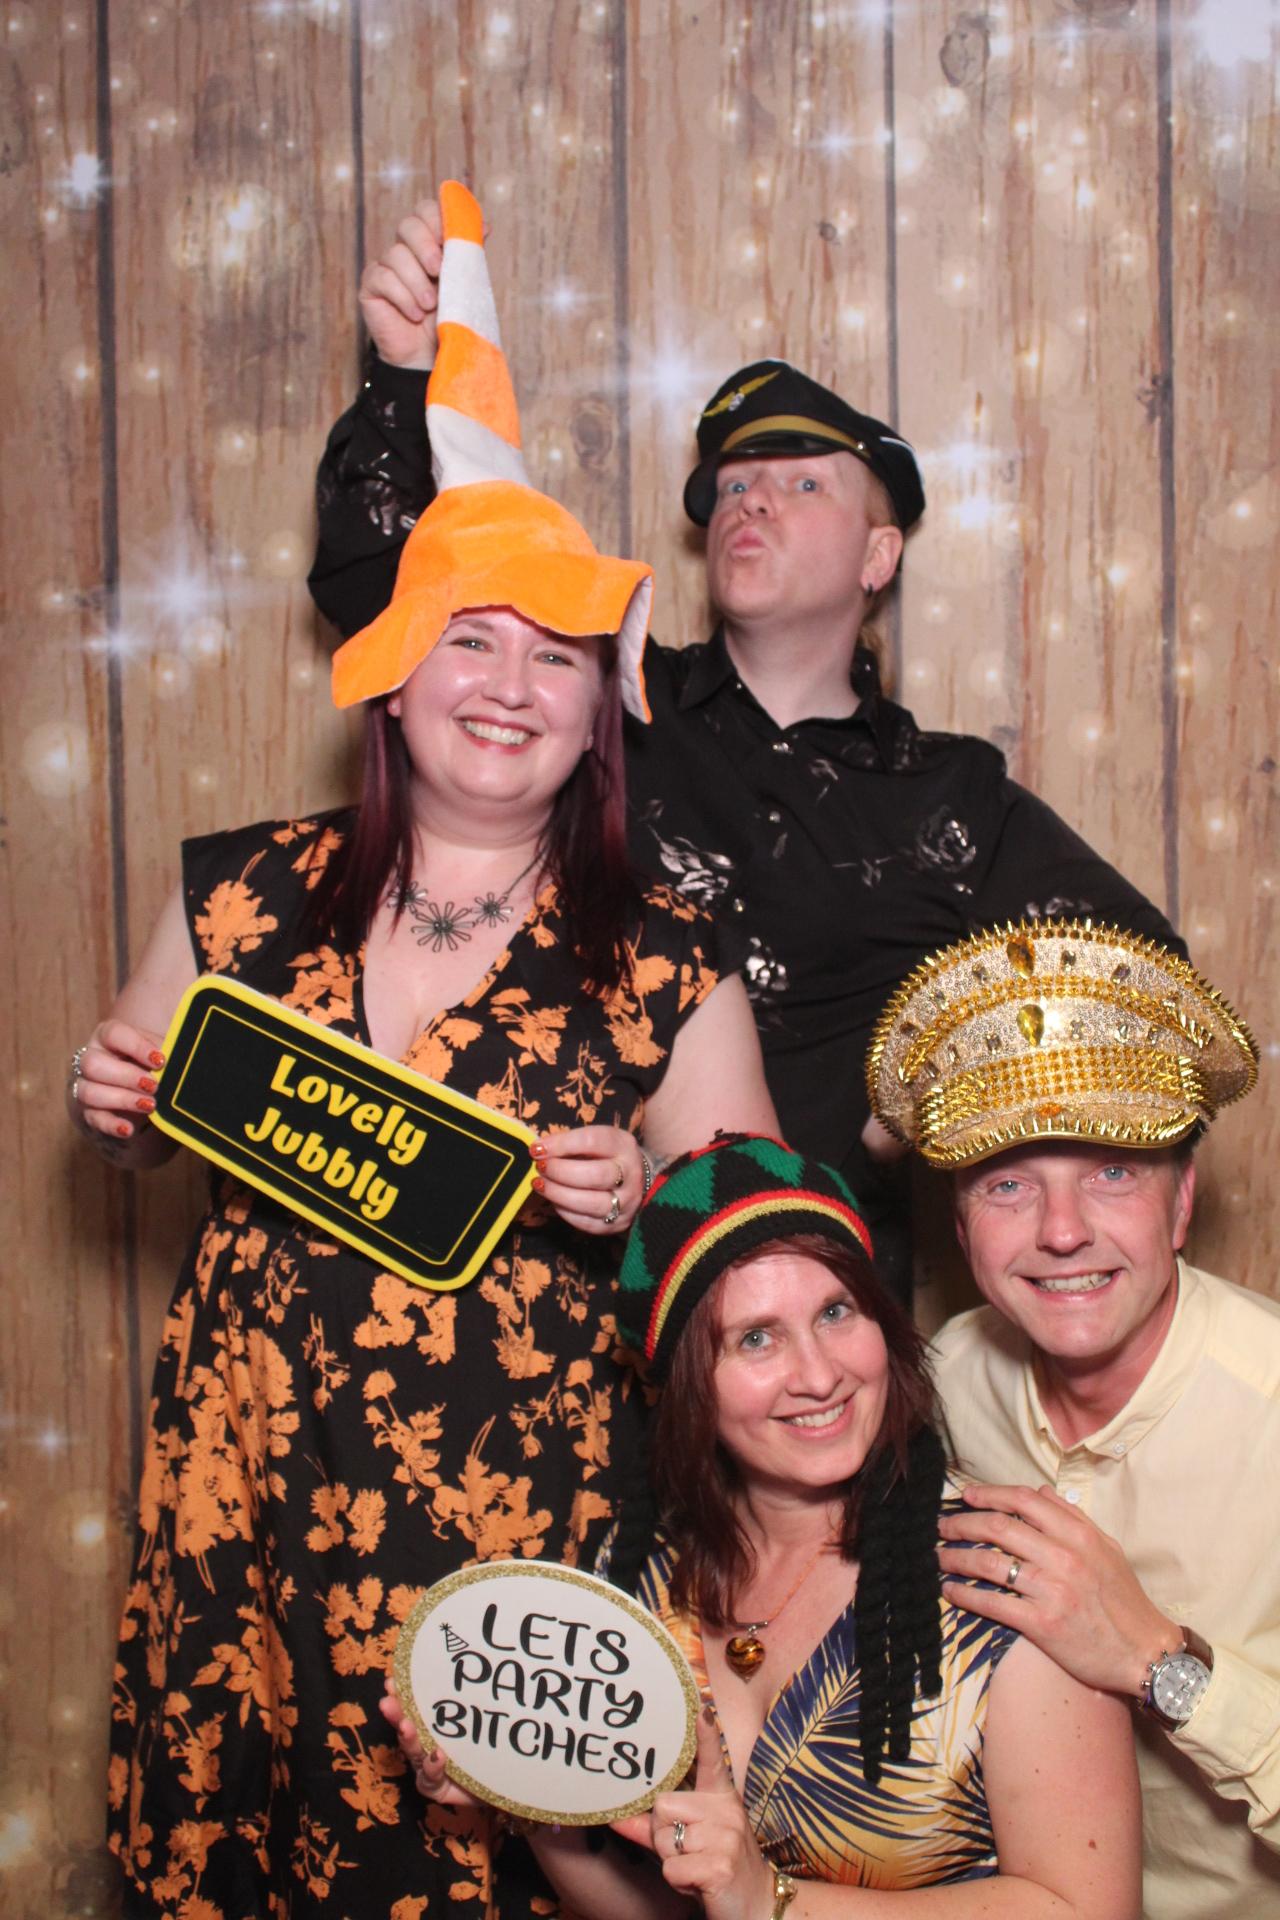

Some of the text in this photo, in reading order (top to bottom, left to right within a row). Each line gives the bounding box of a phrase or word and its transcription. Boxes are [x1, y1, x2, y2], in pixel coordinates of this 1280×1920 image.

[270, 1054, 428, 1166] Lovely
[244, 1107, 399, 1221] Jubbly
[482, 1603, 630, 1675] LETS
[451, 1650, 644, 1728] PARTY
[432, 1699, 656, 1786] BITCHES!
